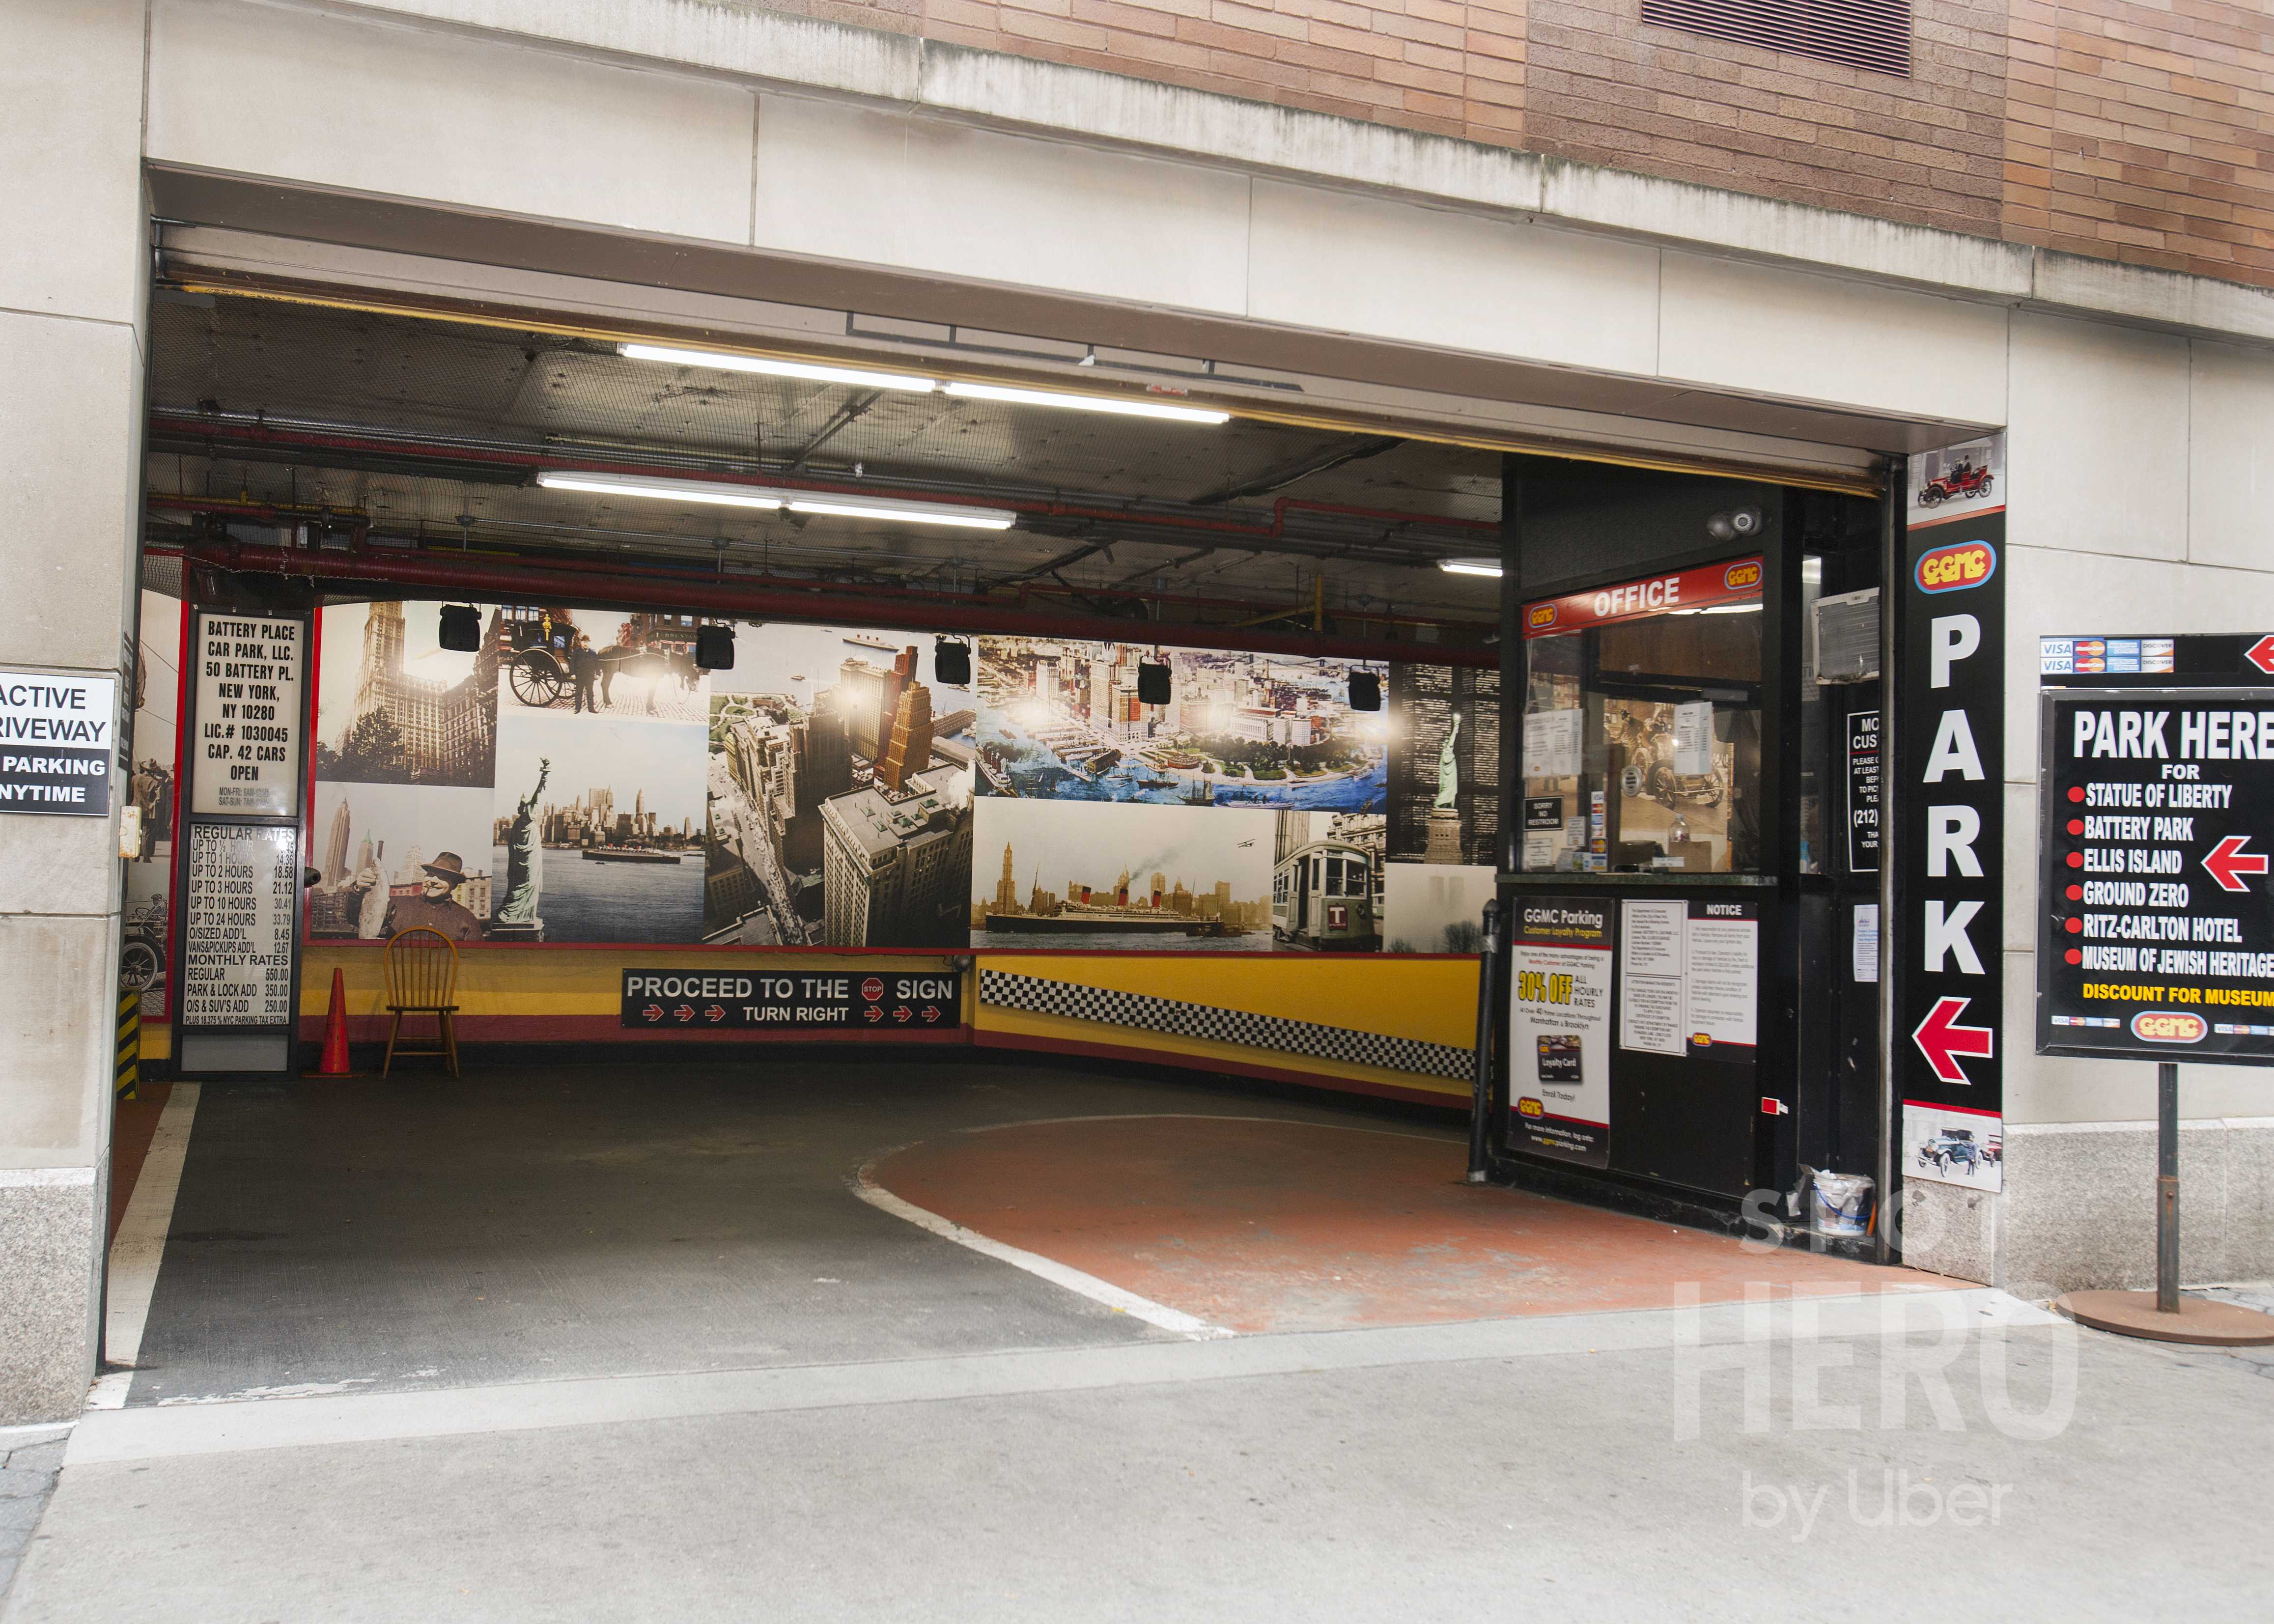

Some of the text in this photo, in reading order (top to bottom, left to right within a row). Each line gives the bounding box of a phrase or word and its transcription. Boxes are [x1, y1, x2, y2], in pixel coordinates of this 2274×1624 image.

[1727, 566, 1759, 586] GGMC
[1923, 550, 1986, 585] GGMC
[1594, 577, 1680, 616] OFFICE
[208, 621, 295, 641] BATTERY PLACE
[208, 641, 293, 661] CAR PARK, LLC.
[2044, 644, 2072, 654] VISA
[206, 662, 293, 681] 50 BATTERY PL.
[2044, 661, 2072, 671] VISA
[219, 683, 280, 702] NEW YORK,
[223, 703, 275, 721] NY 10280
[204, 723, 288, 742] LIC.# 1030045
[2074, 711, 2274, 760] PARK HERE
[208, 744, 285, 762] CAP. 42 CARS
[1853, 757, 1875, 765] PLEASE
[2, 756, 105, 775] PARKING
[230, 765, 259, 781] OPEN
[2162, 764, 2200, 780] FOR
[1923, 614, 1986, 975] PARK
[2086, 783, 2233, 809] STATUE OF LIBERTY
[1853, 809, 1879, 828] (212)
[194, 826, 253, 840] REGULAR
[2084, 815, 2194, 841] BATTERY PARK
[193, 839, 203, 851] UP
[206, 840, 217, 851] TO
[193, 851, 203, 864] UP
[206, 852, 217, 864] TO
[219, 852, 223, 864] 1
[276, 854, 293, 866] 14.36
[2083, 848, 2182, 874] ELLIS ISLAND
[192, 865, 293, 878] UP TO 2 HOURS 18.58
[192, 880, 292, 895] UP TO 3 HOURS 21.12
[2082, 881, 2190, 908] GROUND ZERO
[191, 896, 291, 910] UP TO 10 HOURS 30.41
[1707, 904, 1742, 915] NOTICE
[190, 912, 290, 926] UP TO 24 HOURS 33.79
[1524, 908, 1603, 928] GGMC Parking
[189, 927, 221, 940] O/SIZED
[275, 928, 290, 940] 8.45
[2083, 914, 2243, 943] RITZ-CARLTON HOTEL
[189, 941, 236, 953] VANS&PICKUPS
[274, 942, 289, 953] 12.67
[188, 954, 288, 966] MONTHLY RATES
[2082, 946, 2274, 978] MUSEUM OF JEWISH HERITAGE
[188, 968, 288, 981] REGULAR 550.00
[187, 983, 288, 997] PARK & LOCK ADD 350.00
[627, 977, 752, 998] PROCEED
[760, 978, 793, 998] TO
[801, 979, 849, 999] THE
[896, 980, 952, 999] SIGN
[1518, 971, 1572, 1005] 30% OFF
[2083, 983, 2274, 1007] DISCOUNT FOR MUSEUM
[187, 1000, 199, 1012] O/S
[201, 1000, 206, 1012] &
[232, 1000, 249, 1012] ADD
[265, 1000, 287, 1013] 250.00
[743, 1007, 849, 1021] TURN RIGHT
[186, 1016, 199, 1024] PLUS
[223, 1016, 233, 1024] NYC
[235, 1016, 258, 1024] PARKING
[2139, 1017, 2199, 1037] GGMC
